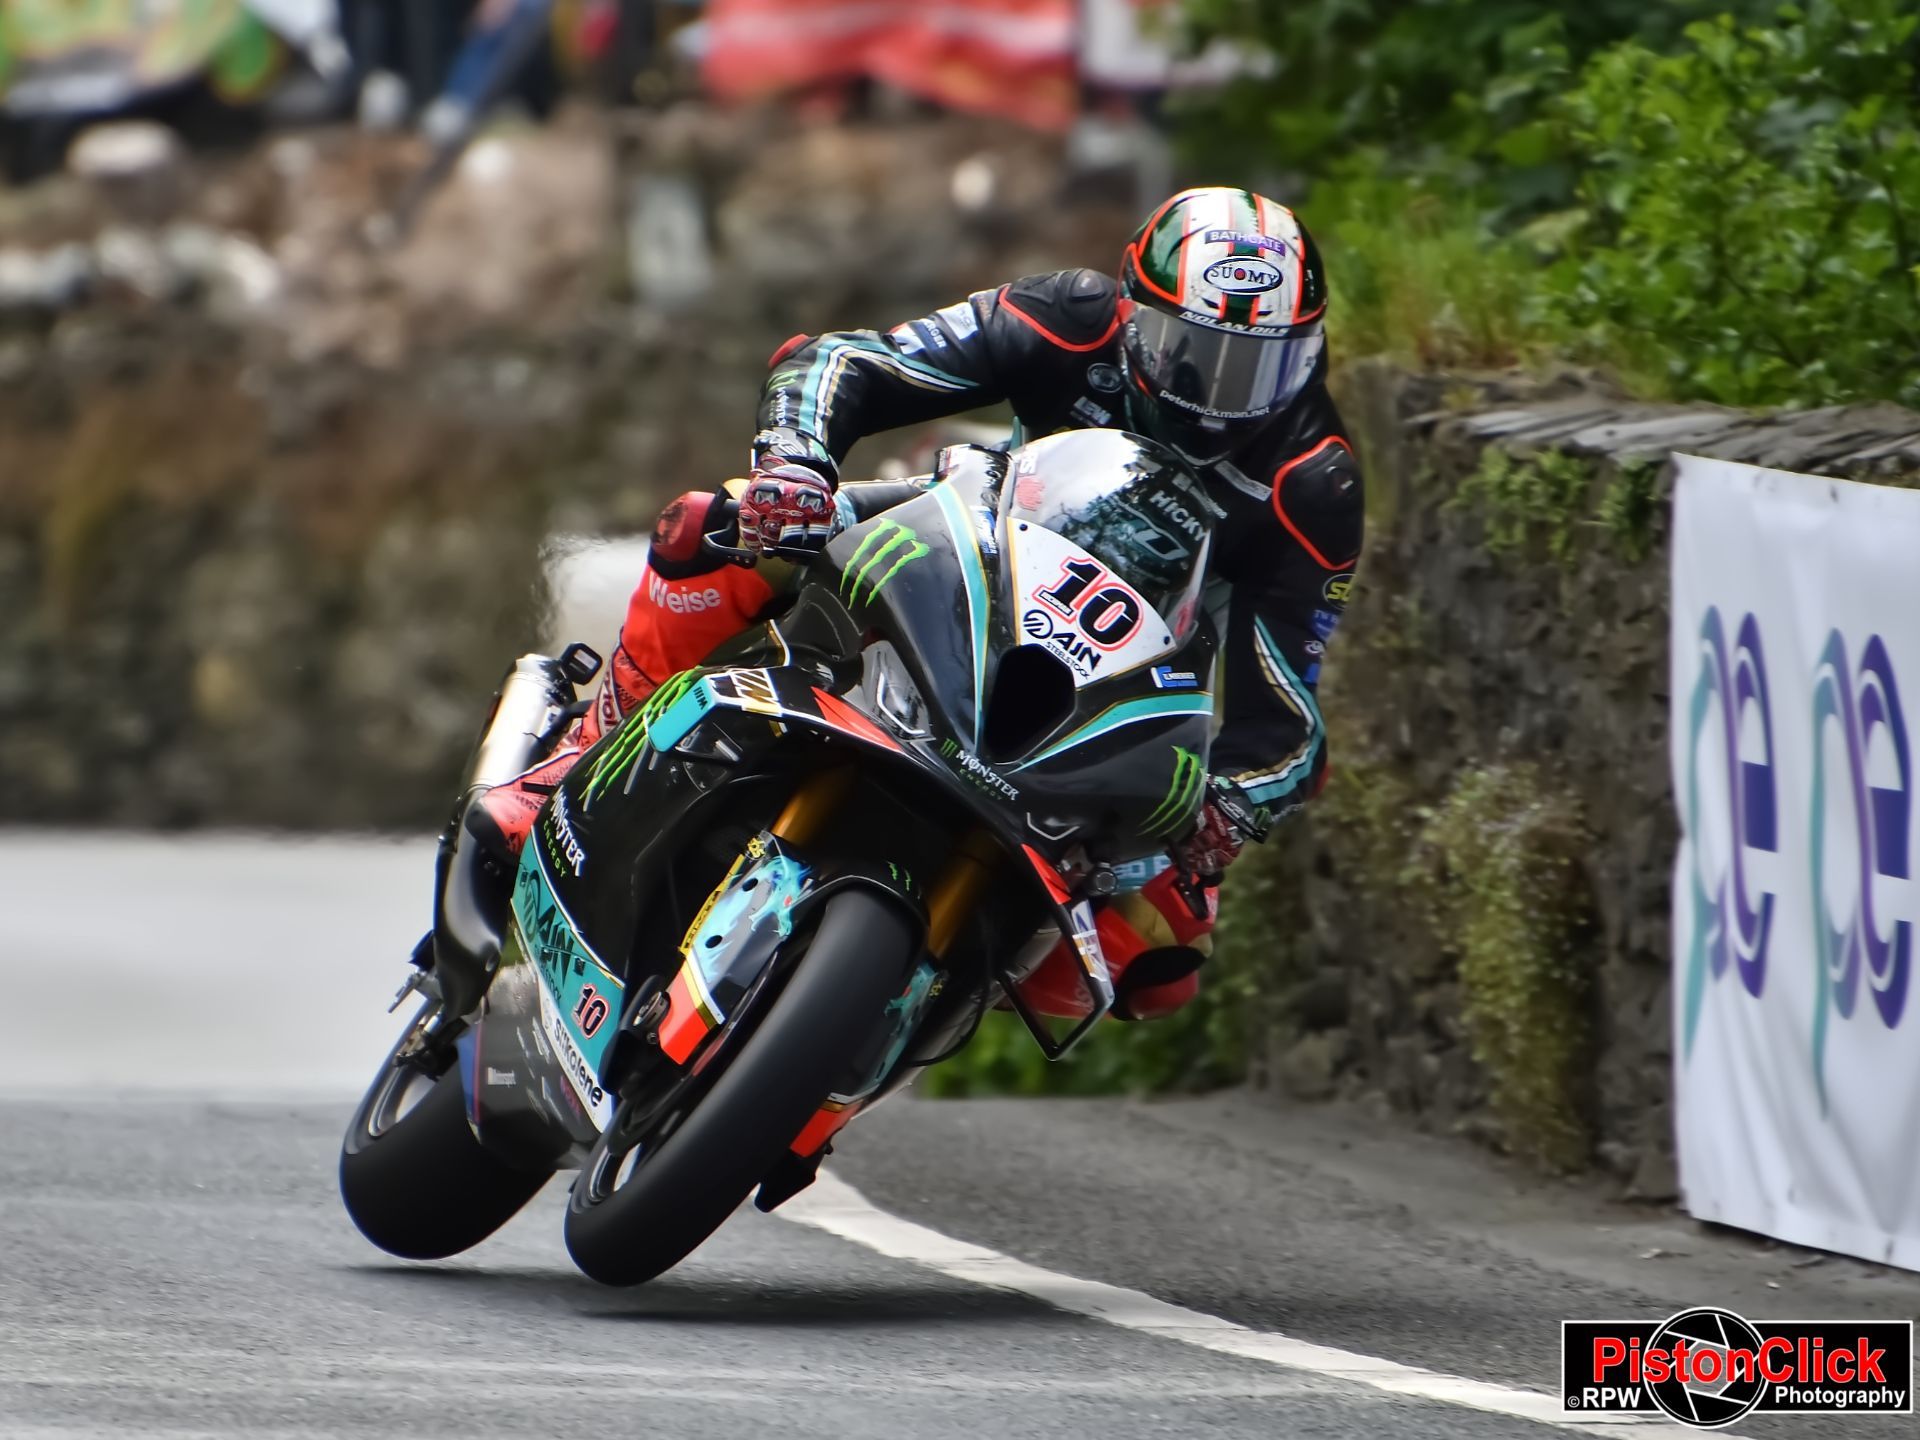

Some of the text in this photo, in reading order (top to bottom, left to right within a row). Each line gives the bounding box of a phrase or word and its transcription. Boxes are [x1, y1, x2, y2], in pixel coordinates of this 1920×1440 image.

[1210, 231, 1281, 251] BATHGATE
[1210, 265, 1278, 286] SUOMY
[1179, 310, 1290, 334] NOLAN OILS
[1159, 389, 1270, 419] peterhickman.net
[1149, 489, 1208, 542] HICKY
[649, 569, 721, 614] Weise
[1033, 557, 1143, 651] 10
[1045, 641, 1091, 679] STEELSTOCK
[955, 750, 1019, 801] MONSTER
[550, 784, 585, 877] MONSTER
[572, 984, 611, 1040] 10
[553, 1018, 604, 1108] Silkolene
